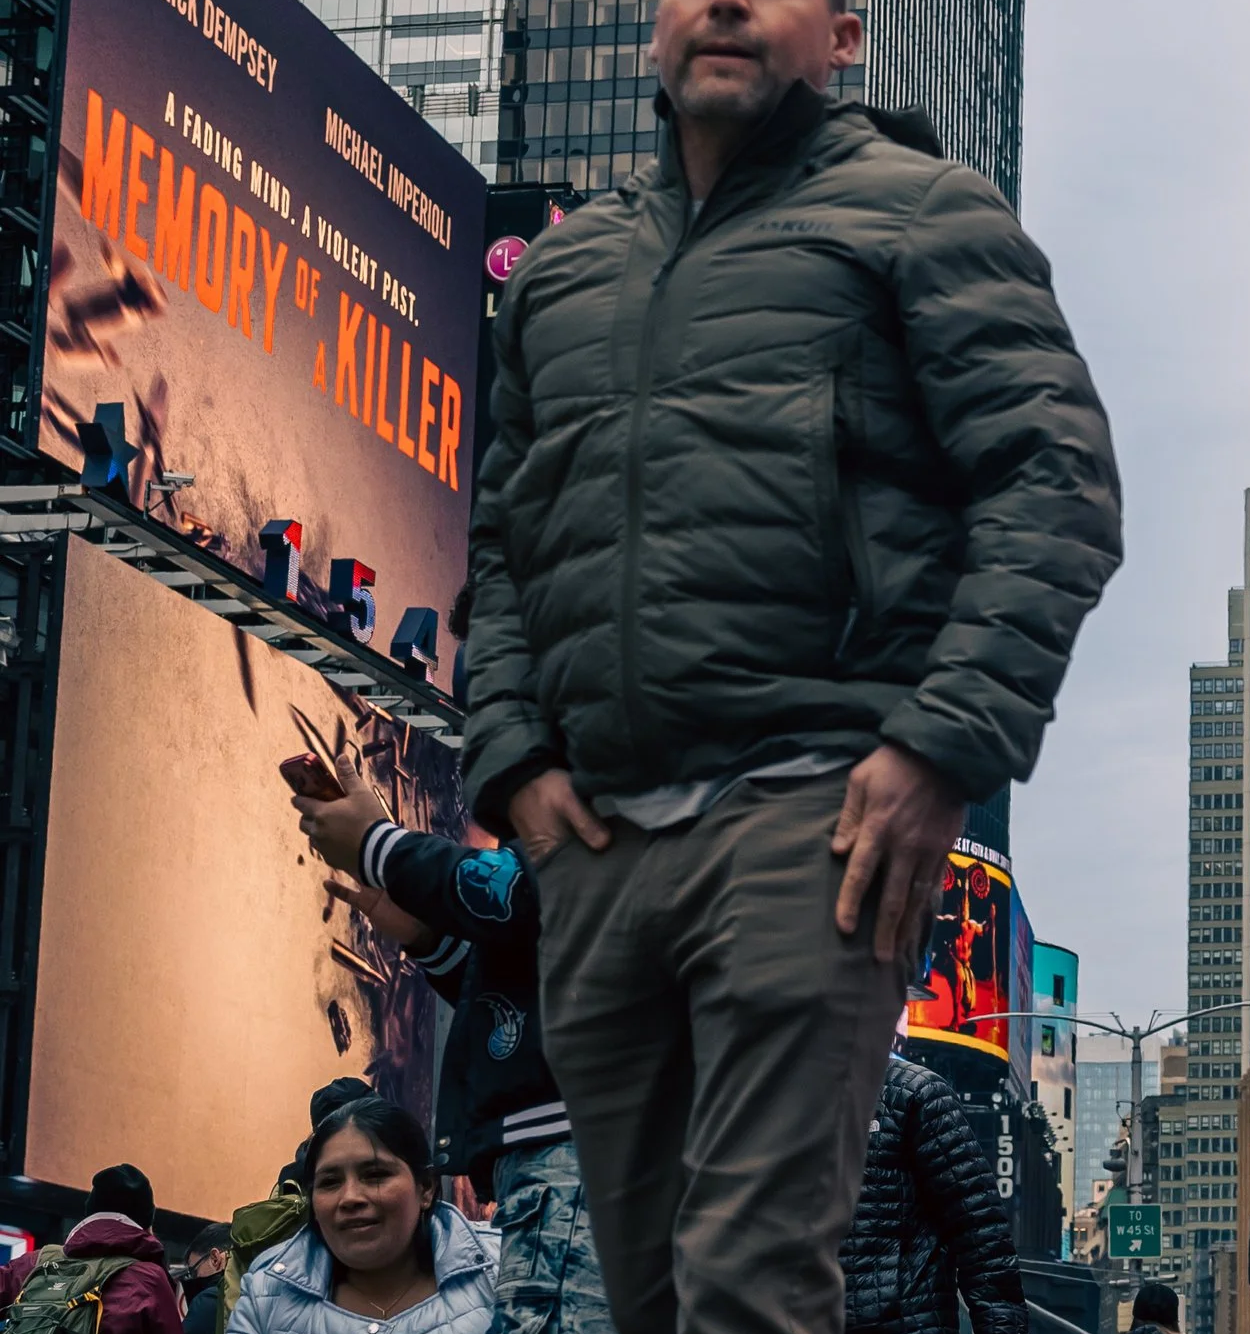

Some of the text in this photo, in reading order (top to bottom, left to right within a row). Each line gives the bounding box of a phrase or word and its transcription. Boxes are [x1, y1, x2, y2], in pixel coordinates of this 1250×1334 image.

[81, 88, 320, 355] MEMORY OF
[164, 91, 420, 327] A FADING MIND. A VIOLENT PAST.
[325, 106, 452, 251] MICHAEL IMPERIOLI
[313, 291, 463, 492] A KILLER
[997, 1114, 1014, 1199] 1500
[1129, 1210, 1142, 1221] TO
[1116, 1225, 1155, 1235] W 45 St
